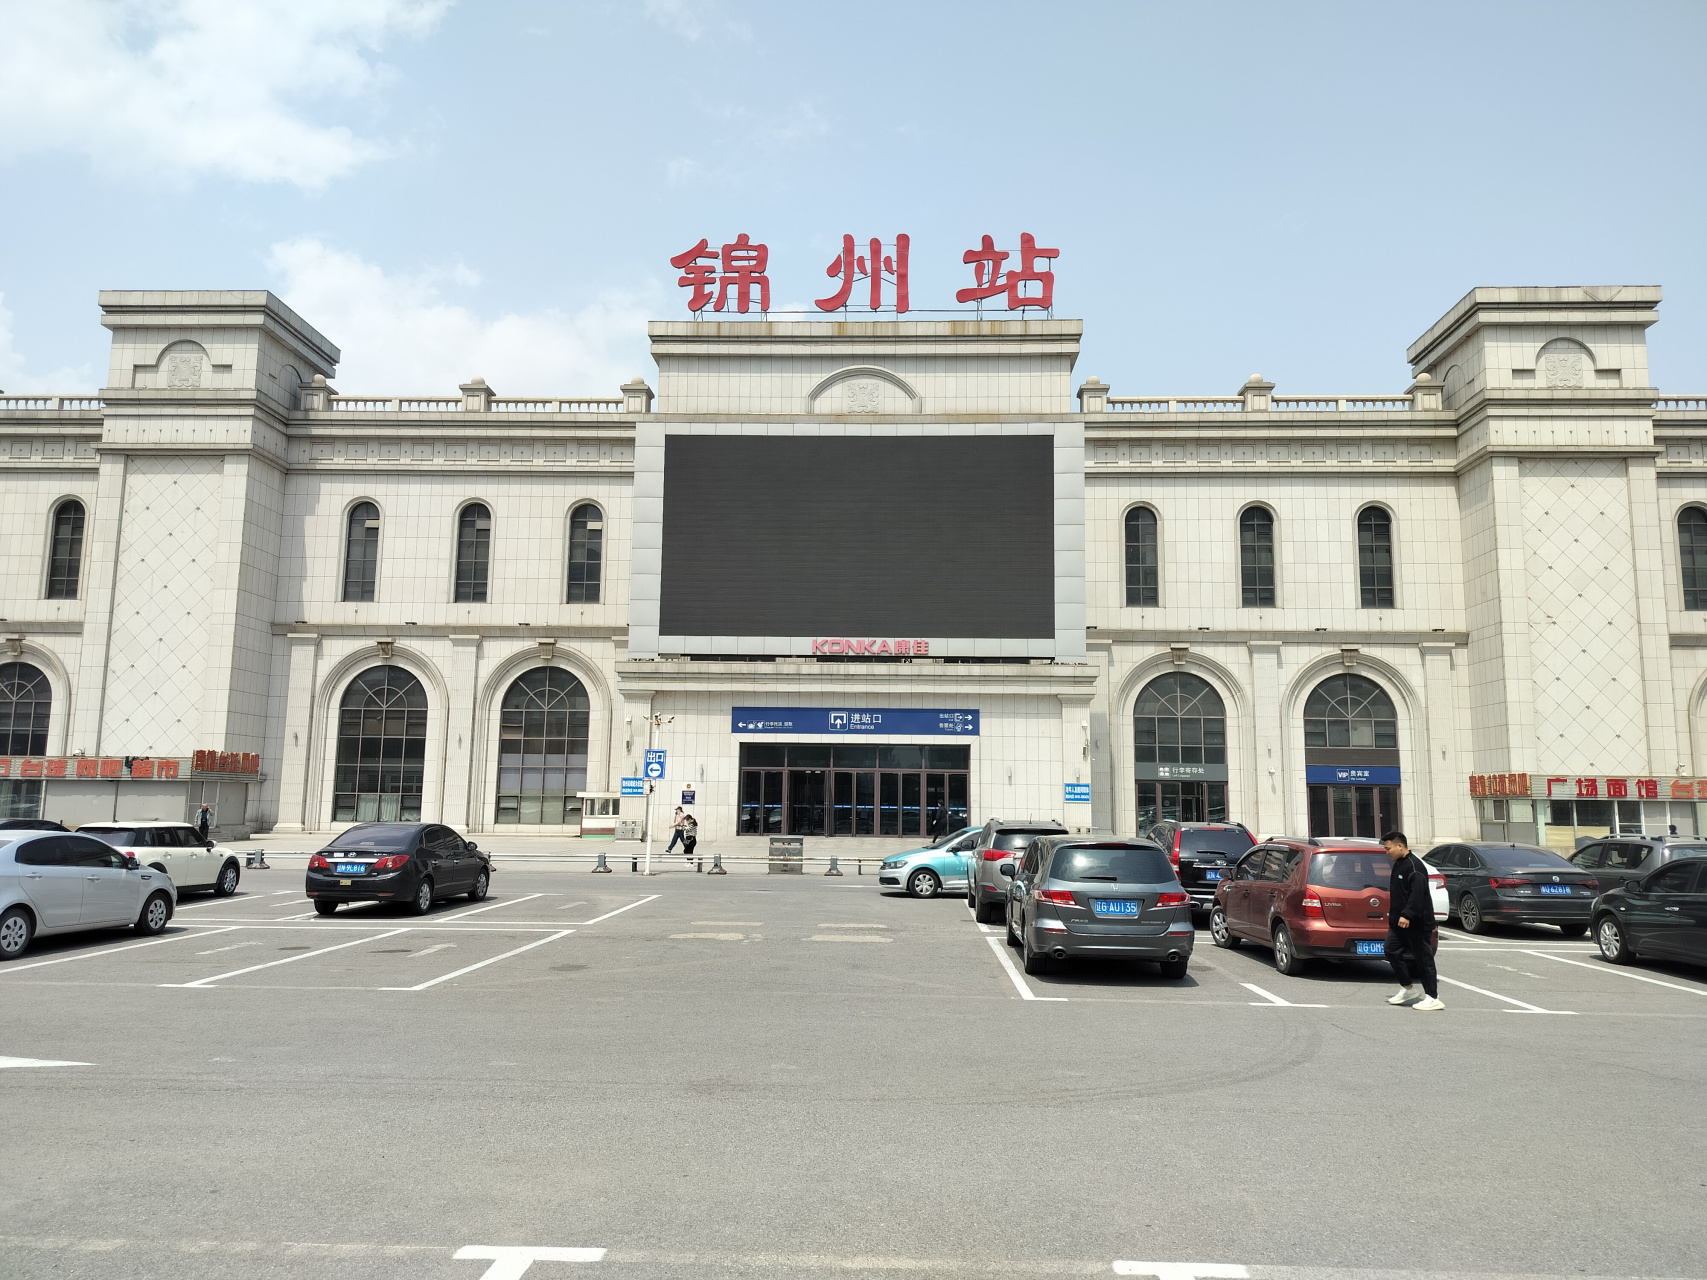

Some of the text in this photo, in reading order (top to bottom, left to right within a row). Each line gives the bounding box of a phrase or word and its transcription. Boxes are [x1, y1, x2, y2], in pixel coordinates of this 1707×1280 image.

[670, 232, 1060, 313] 锦州站
[850, 713, 882, 724] 进站口
[646, 752, 664, 763] 出口
[1350, 769, 1370, 777] 贵宾室
[1546, 777, 1658, 799] 广场面馆
